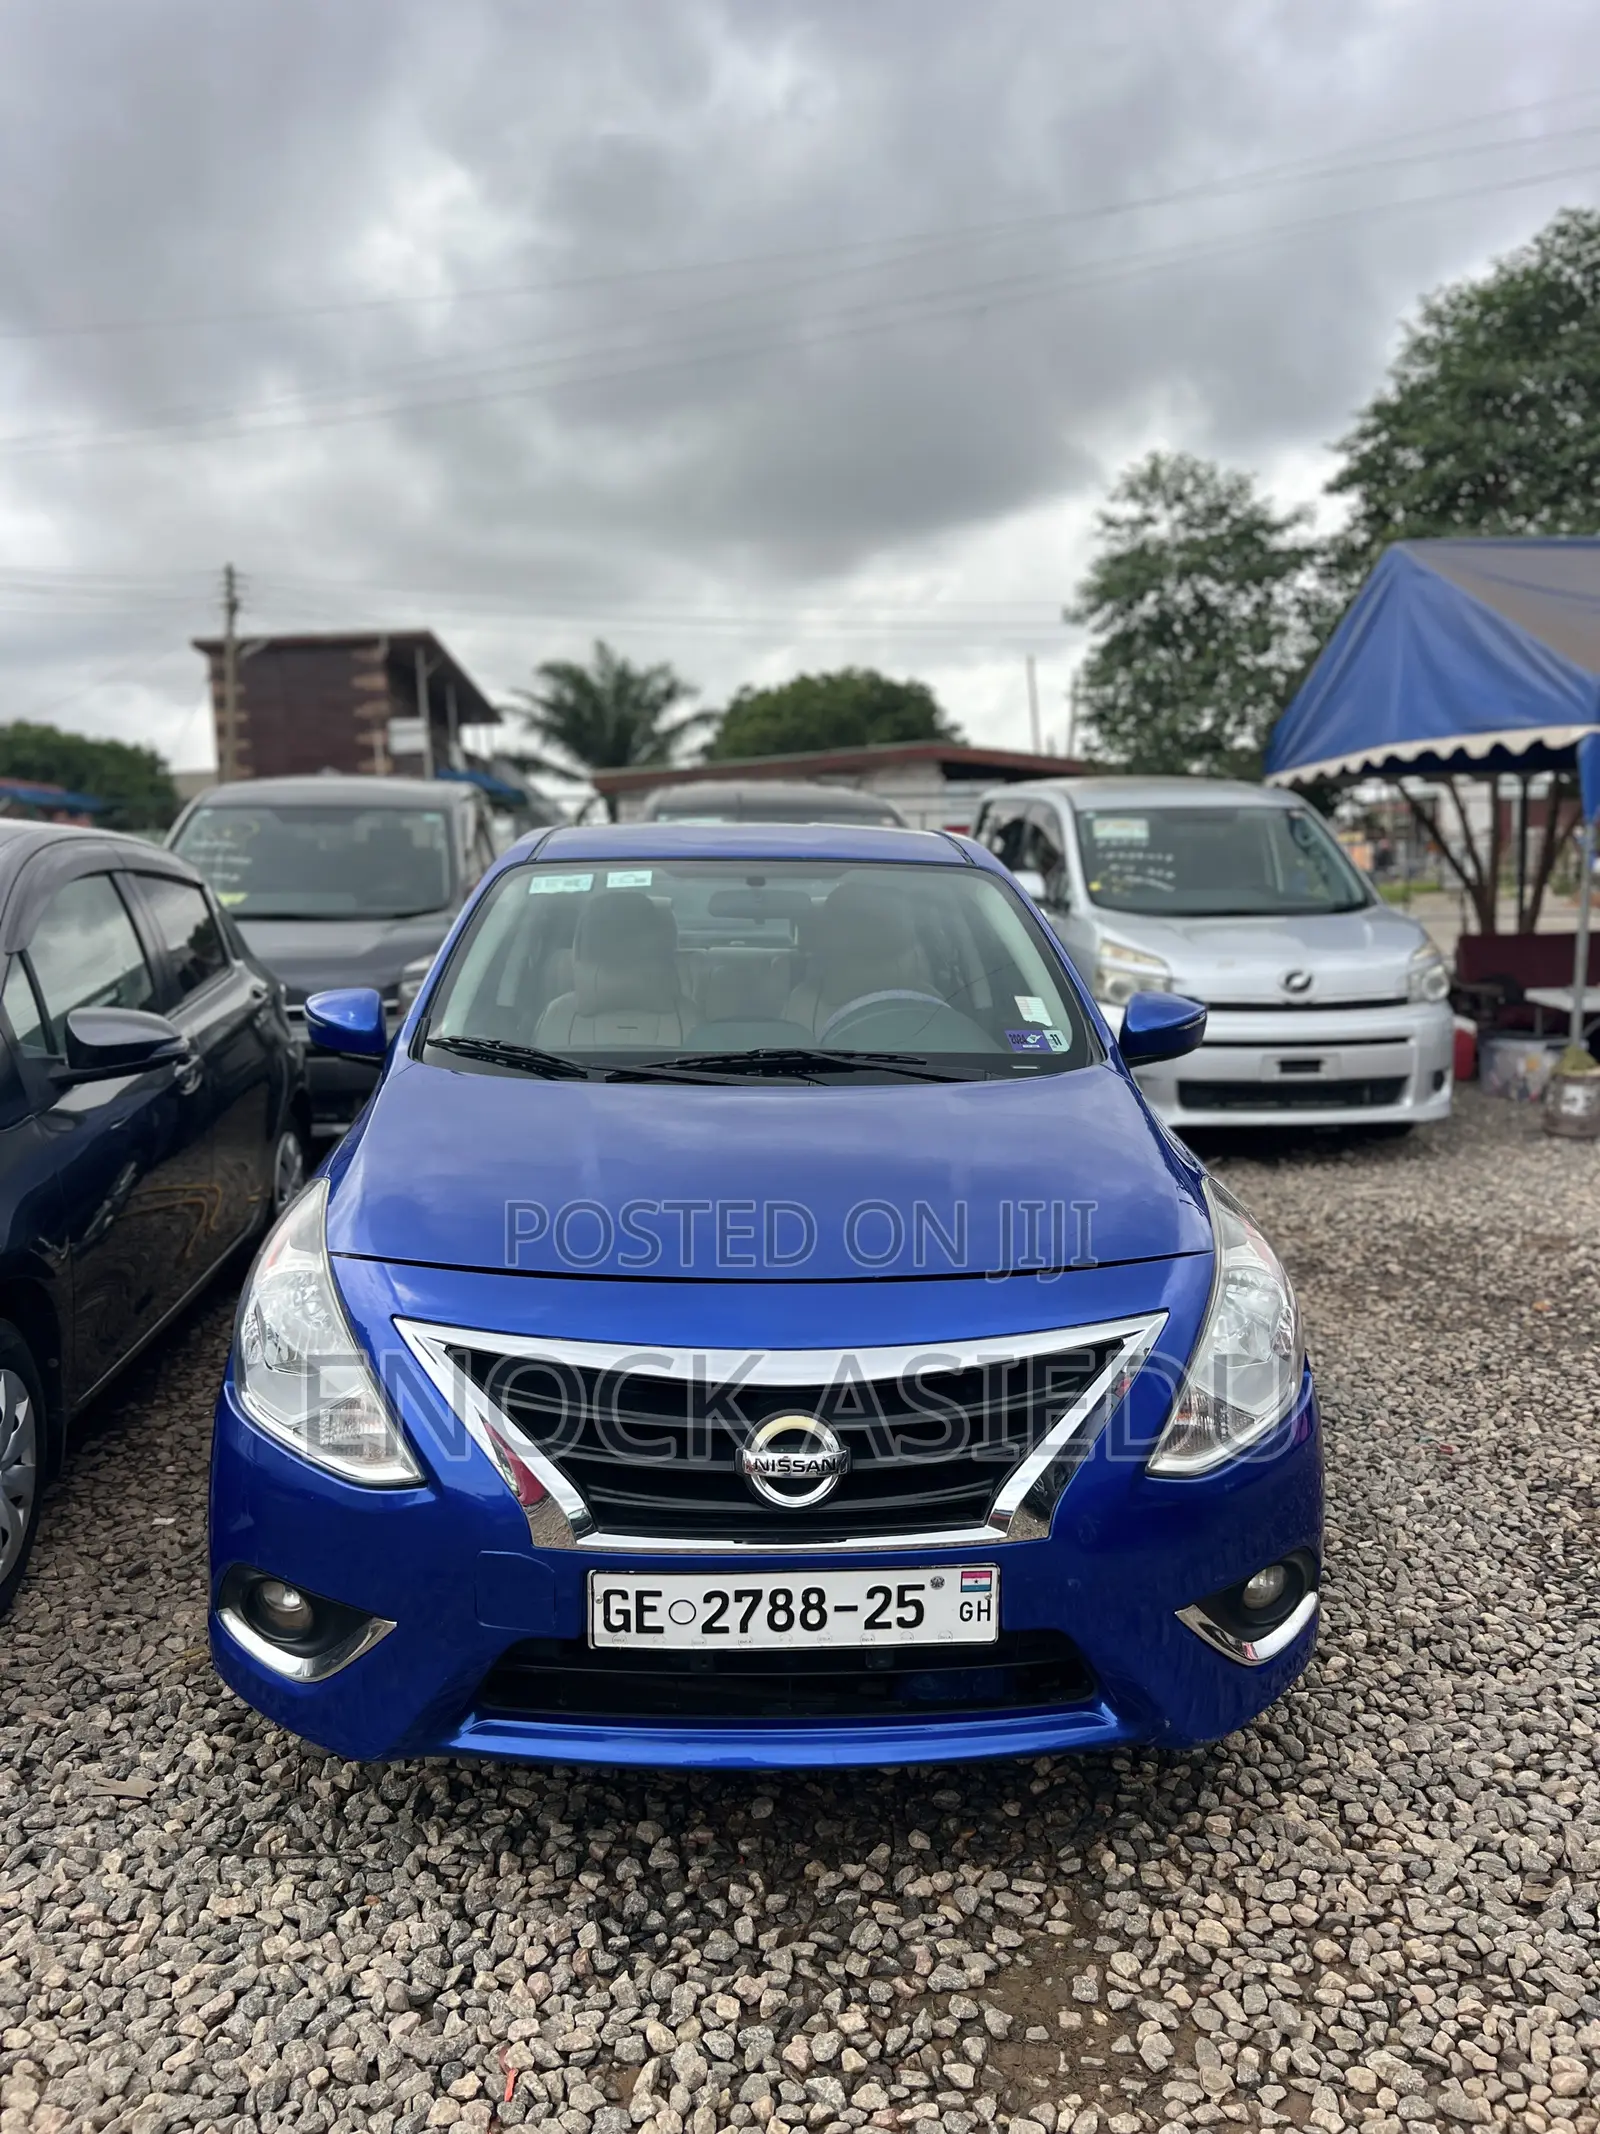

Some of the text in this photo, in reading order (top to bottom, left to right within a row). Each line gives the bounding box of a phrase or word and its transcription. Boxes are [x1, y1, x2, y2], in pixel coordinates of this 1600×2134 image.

[754, 1457, 837, 1473] NISSAN
[602, 1584, 926, 1634] GE 2788-25
[958, 1600, 992, 1623] GH
